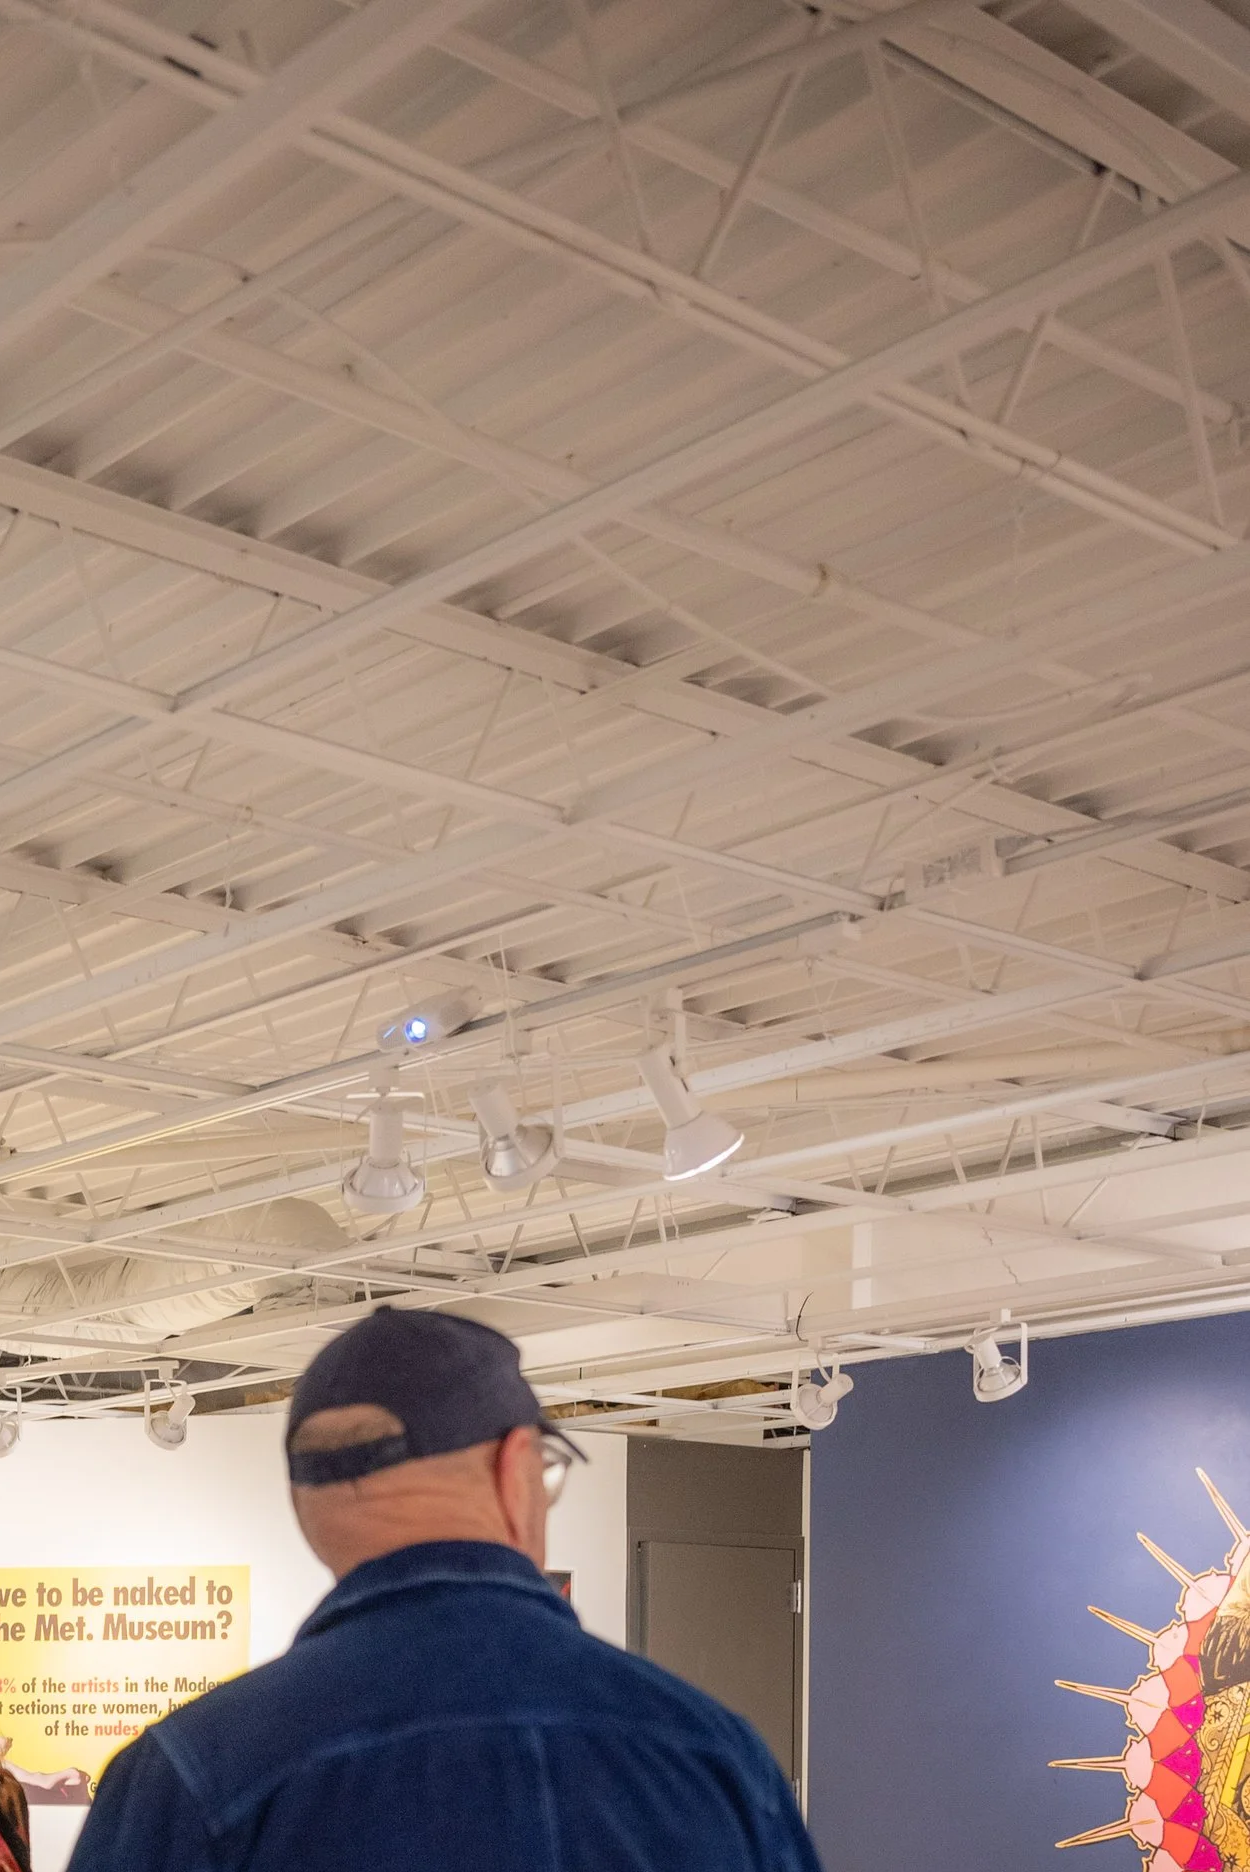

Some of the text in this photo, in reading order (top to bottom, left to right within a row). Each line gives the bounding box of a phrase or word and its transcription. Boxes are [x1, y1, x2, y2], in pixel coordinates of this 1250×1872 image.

[36, 1582, 62, 1607] to
[72, 1577, 104, 1607] be
[113, 1576, 196, 1606] naked
[206, 1580, 233, 1605] to
[34, 1614, 94, 1641] Met.
[102, 1610, 233, 1641] Museum?
[21, 1677, 37, 1693] of
[42, 1677, 66, 1693] the
[71, 1677, 119, 1693] artists
[125, 1677, 138, 1693] in
[145, 1677, 168, 1693] the
[174, 1676, 225, 1692] Mode
[8, 1699, 67, 1715] sections
[72, 1703, 97, 1714] are
[102, 1703, 162, 1718] women,
[44, 1720, 60, 1736] of
[64, 1720, 89, 1736] the
[94, 1720, 139, 1736] nudes
